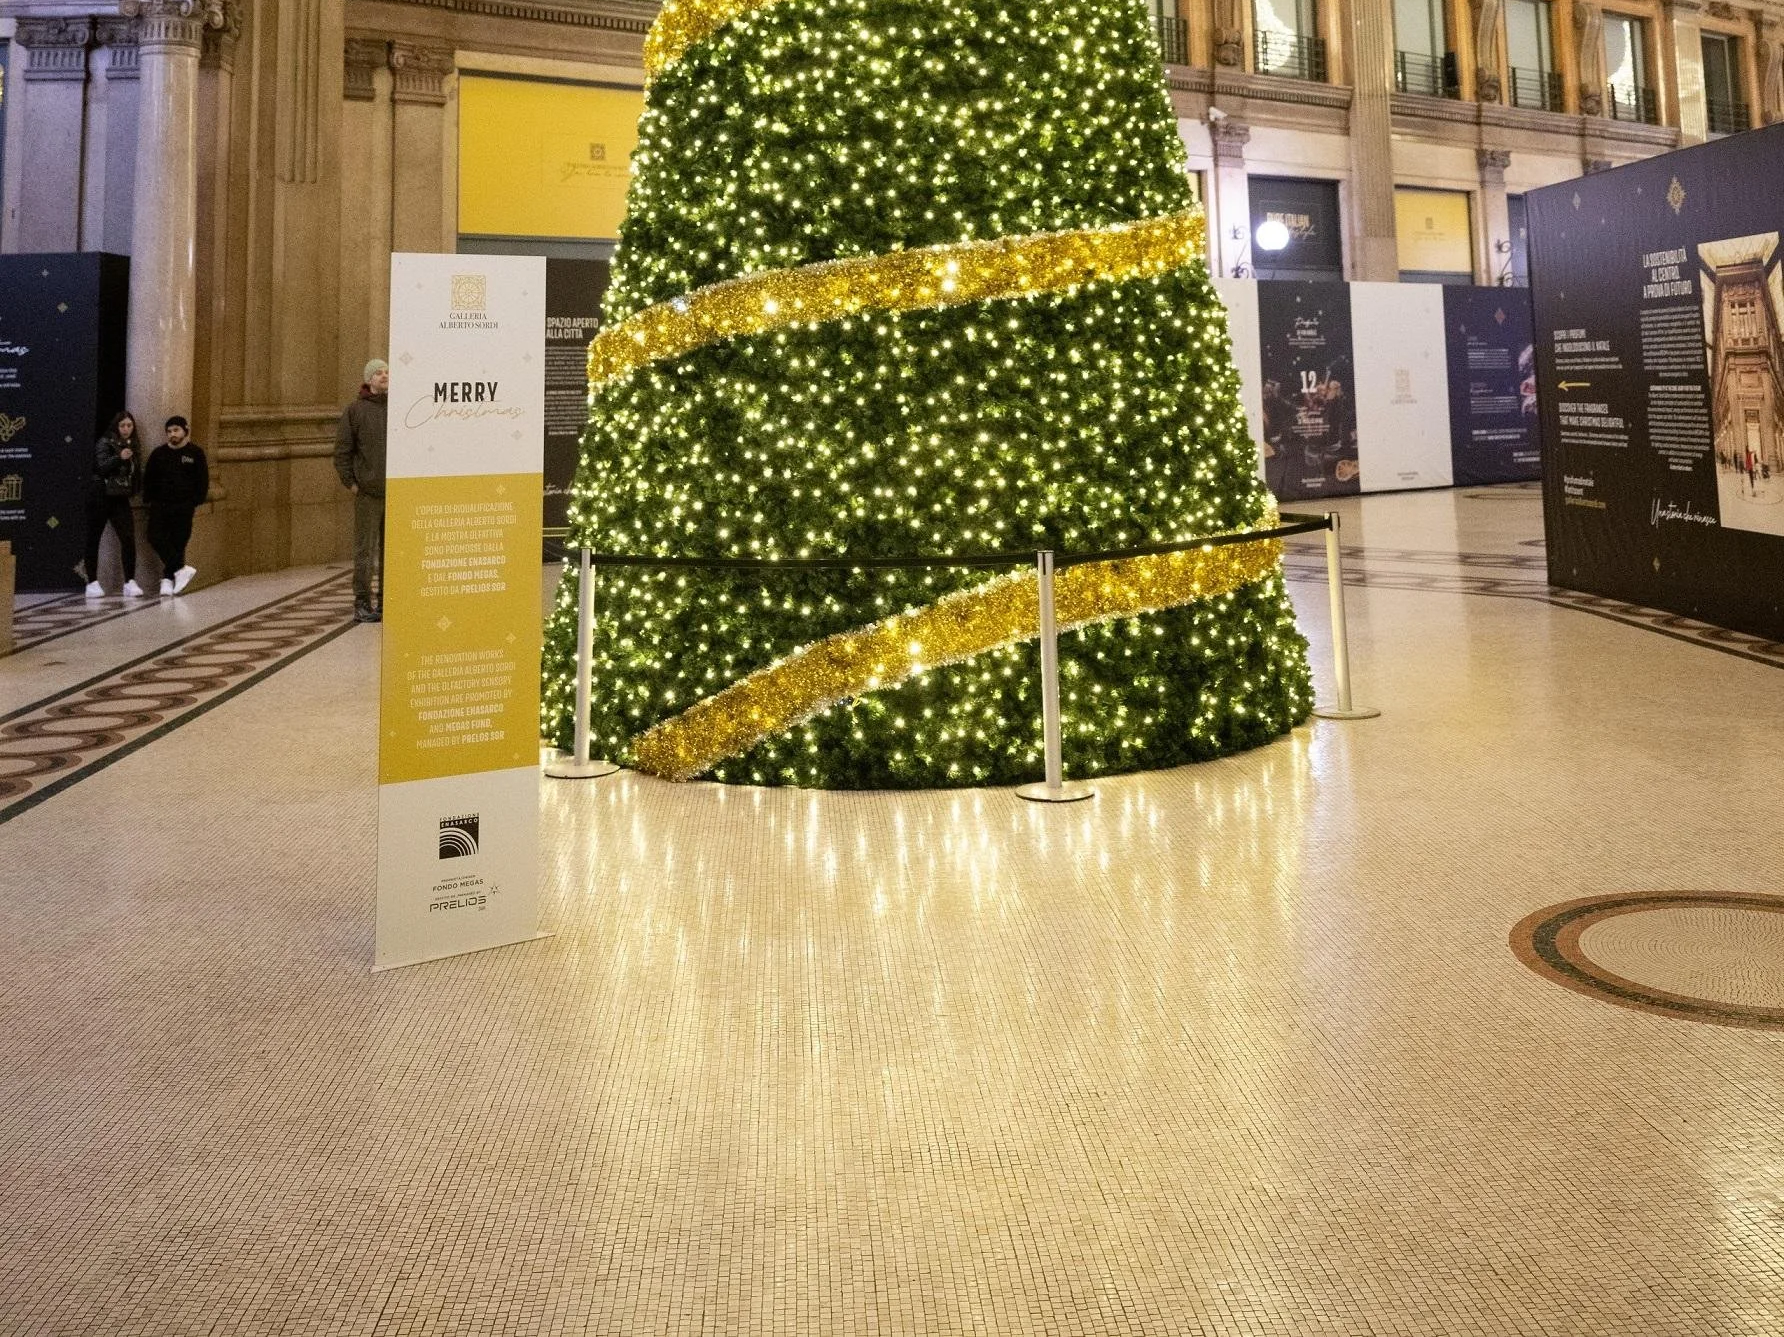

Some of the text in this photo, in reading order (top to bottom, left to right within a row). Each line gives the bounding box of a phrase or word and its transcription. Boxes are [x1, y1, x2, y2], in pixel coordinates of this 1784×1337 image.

[450, 312, 487, 320] GALLERIA
[546, 317, 598, 328] SPAZIO APERTO
[439, 321, 498, 329] ALBERTO SORDI
[546, 327, 583, 339] ALLA CITTÀ
[1301, 370, 1317, 394] 12
[434, 381, 498, 403] MERRY
[405, 394, 525, 429] Christmas
[411, 515, 517, 529] DELLA GALLERIA ALBERTO SORDI
[431, 532, 439, 541] LA
[441, 530, 468, 541] MOSTRA
[424, 542, 504, 556] SONO PROMOSSE DALLA
[421, 555, 506, 569] FONDAZIONE ENASARCO
[448, 571, 472, 581] FONDO
[420, 582, 506, 597] GESTITO DA PRELIOS SGR
[420, 649, 504, 665] THE RENOVATION WORKS
[408, 662, 516, 680] OF THE GALLERIA ALBERTO SORDI
[411, 676, 512, 694] AND THE OLFACTORY SENSORY
[410, 689, 513, 708] EXHIBITION ARE PROMOTED BY
[418, 703, 504, 721] FONDAZIONE ENASARCO
[429, 724, 444, 735] AND
[445, 721, 470, 732] MEGAS
[416, 737, 450, 749] MANAGED
[452, 736, 461, 745] BY
[490, 731, 505, 740] SGR
[440, 812, 479, 821] FONDAZIONE
[441, 818, 478, 828] ENASARCO
[432, 883, 457, 892] FONDO
[460, 878, 484, 887] MEGAS
[429, 895, 487, 913] PRELIOS
